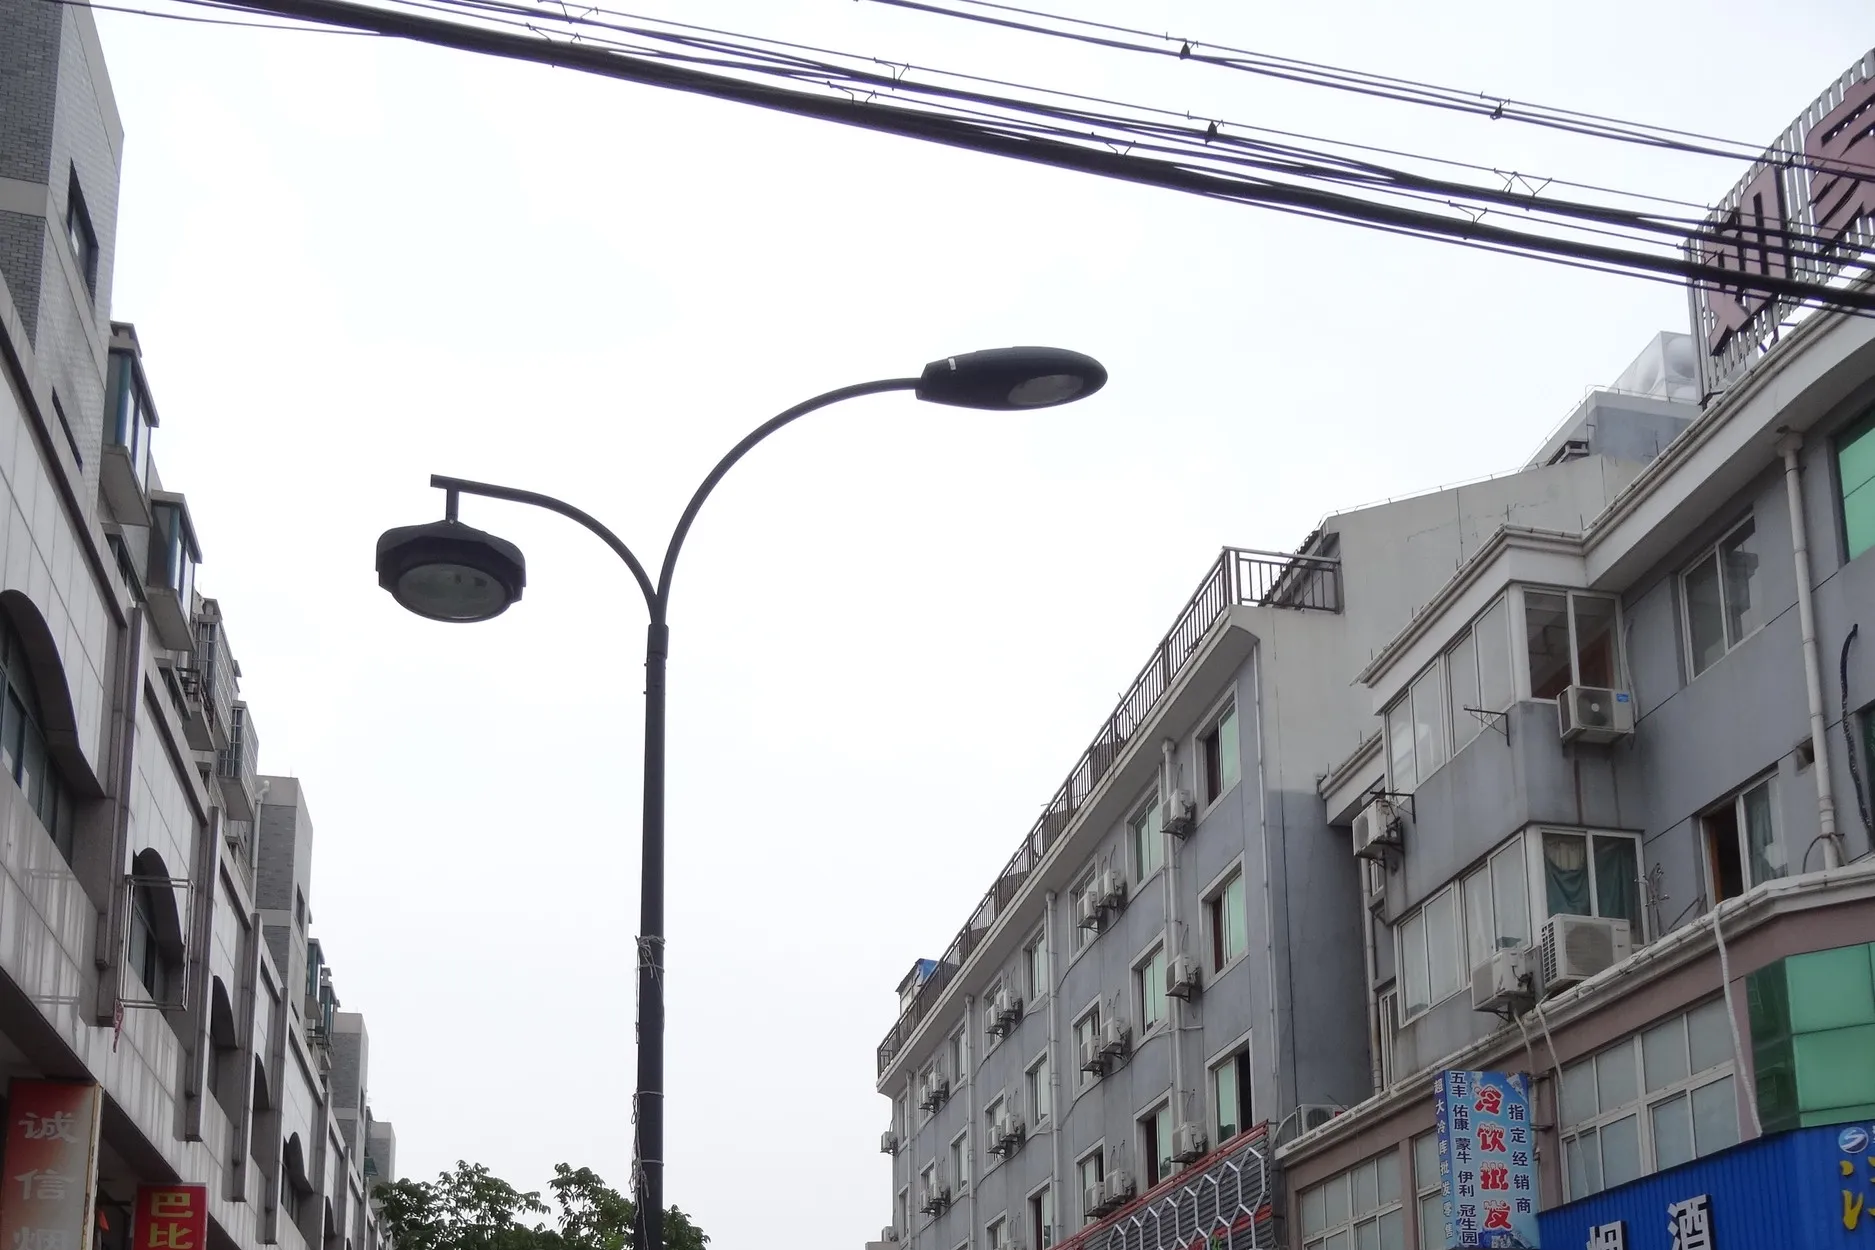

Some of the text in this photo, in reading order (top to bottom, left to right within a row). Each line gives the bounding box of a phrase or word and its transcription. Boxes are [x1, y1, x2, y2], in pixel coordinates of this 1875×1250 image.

[1455, 1137, 1472, 1164] 蒙牛
[1474, 1084, 1512, 1230] 冷饮批发
[1507, 1104, 1532, 1214] 指定经销商
[1457, 1170, 1475, 1198] 伊利
[1459, 1204, 1478, 1246] 冠生园
